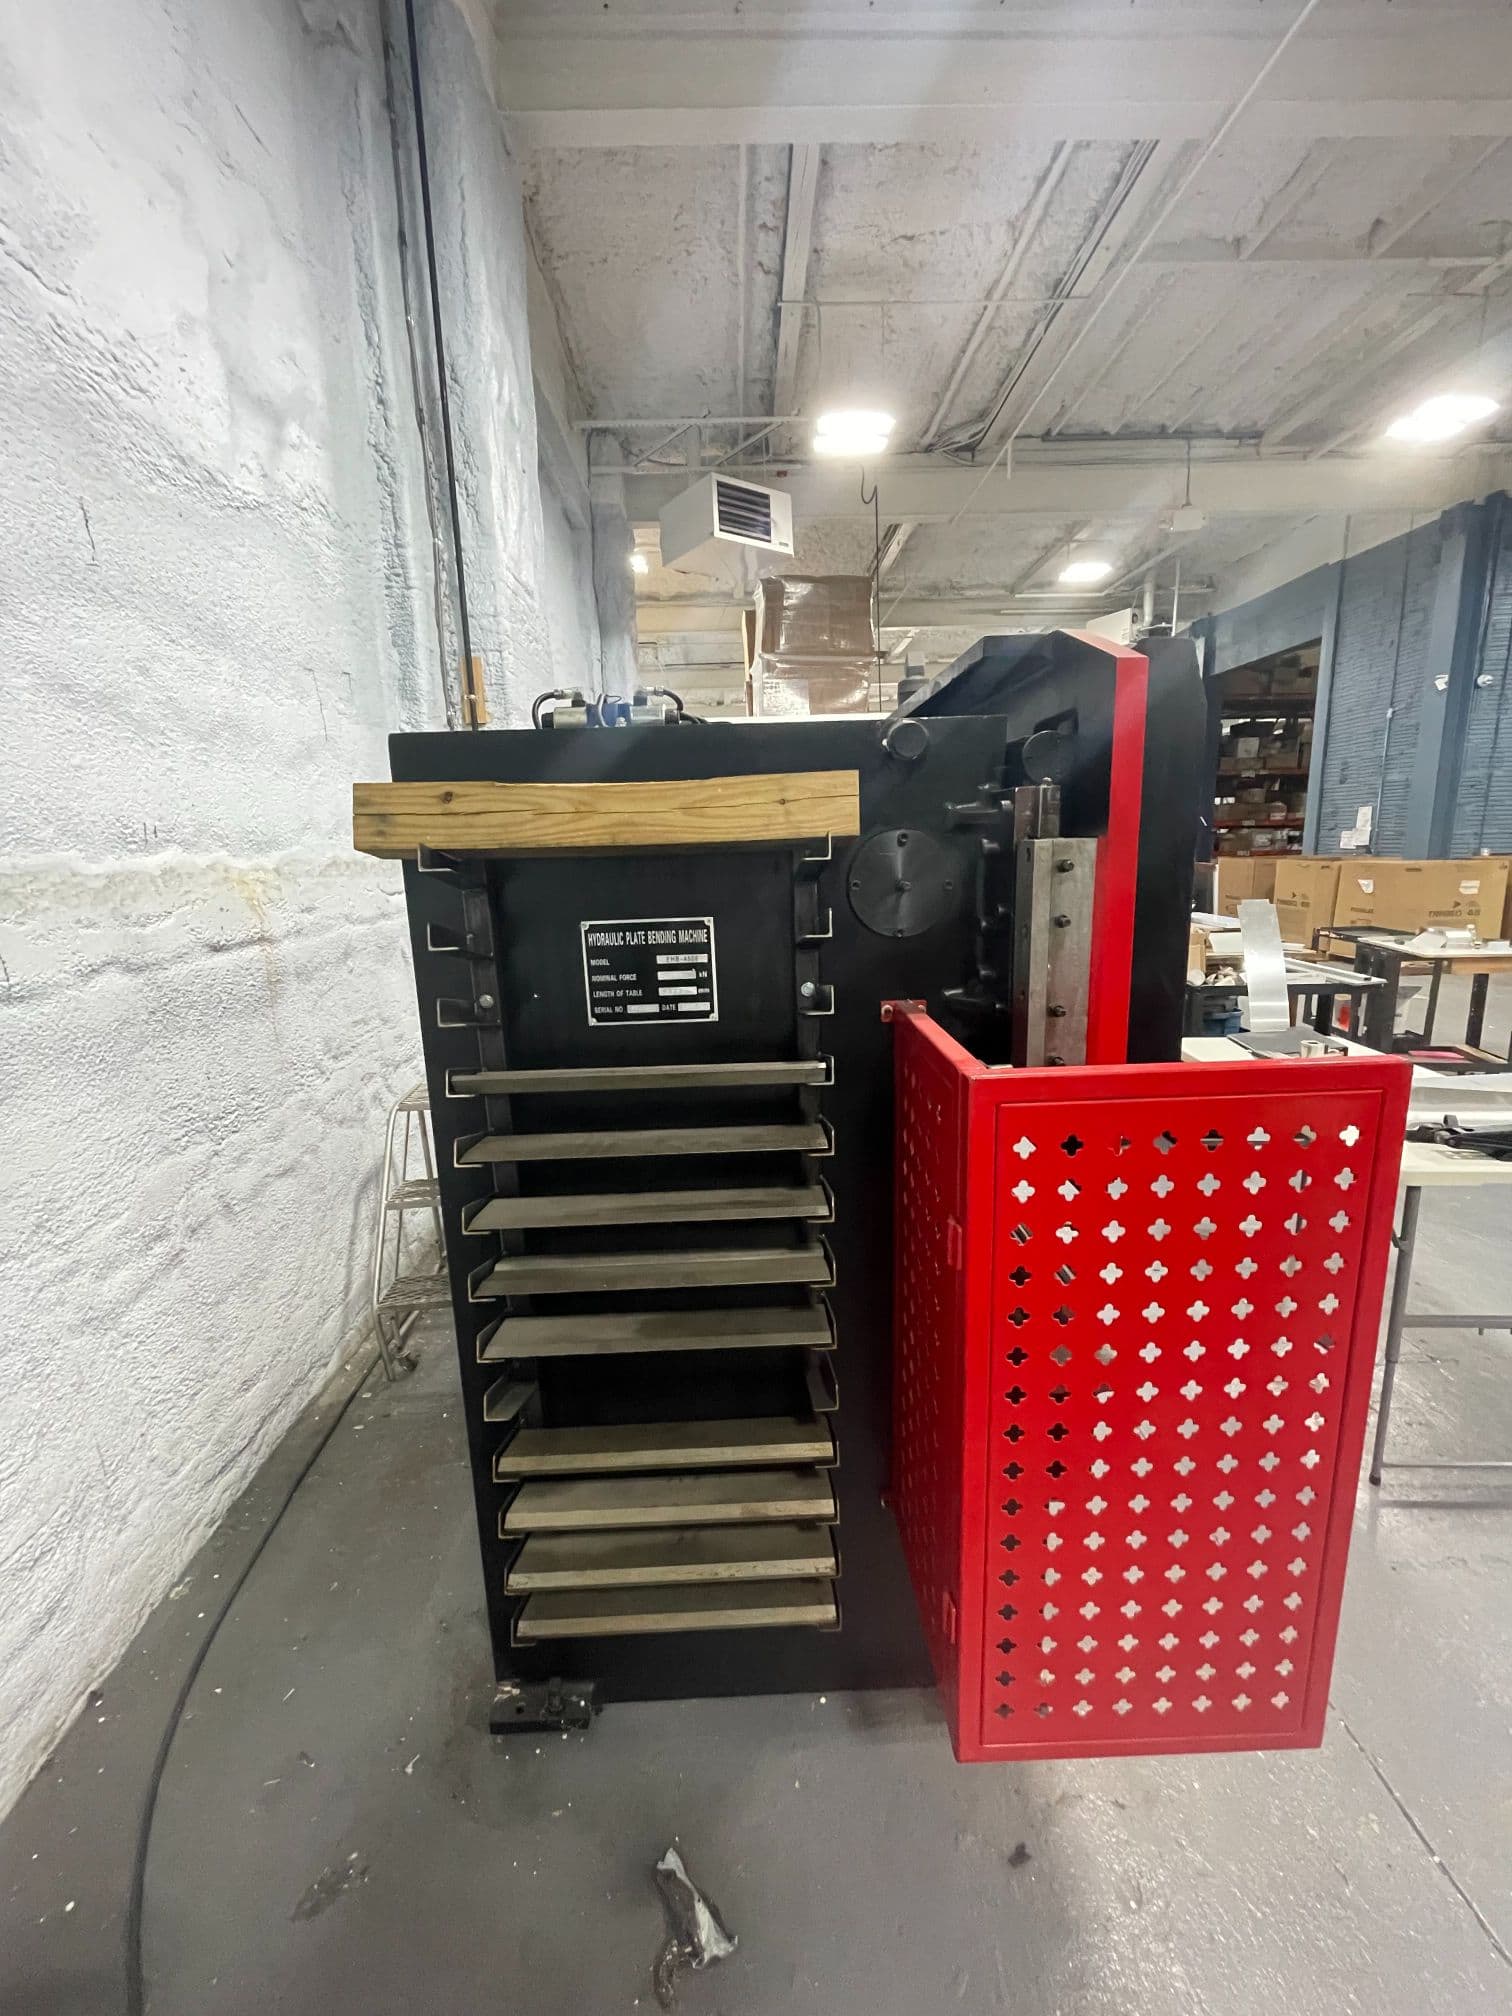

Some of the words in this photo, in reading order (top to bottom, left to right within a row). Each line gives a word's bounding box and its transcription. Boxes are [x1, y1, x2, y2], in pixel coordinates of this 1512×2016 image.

[587, 931, 624, 947] HYDRAULIC
[625, 930, 646, 945] PLATE
[647, 929, 677, 944] BENDING
[678, 928, 708, 943] MACHINE
[590, 958, 610, 966] MODEL
[619, 973, 637, 981] FORCE
[592, 990, 615, 998] LENGTH
[594, 1006, 613, 1014] SERIAL
